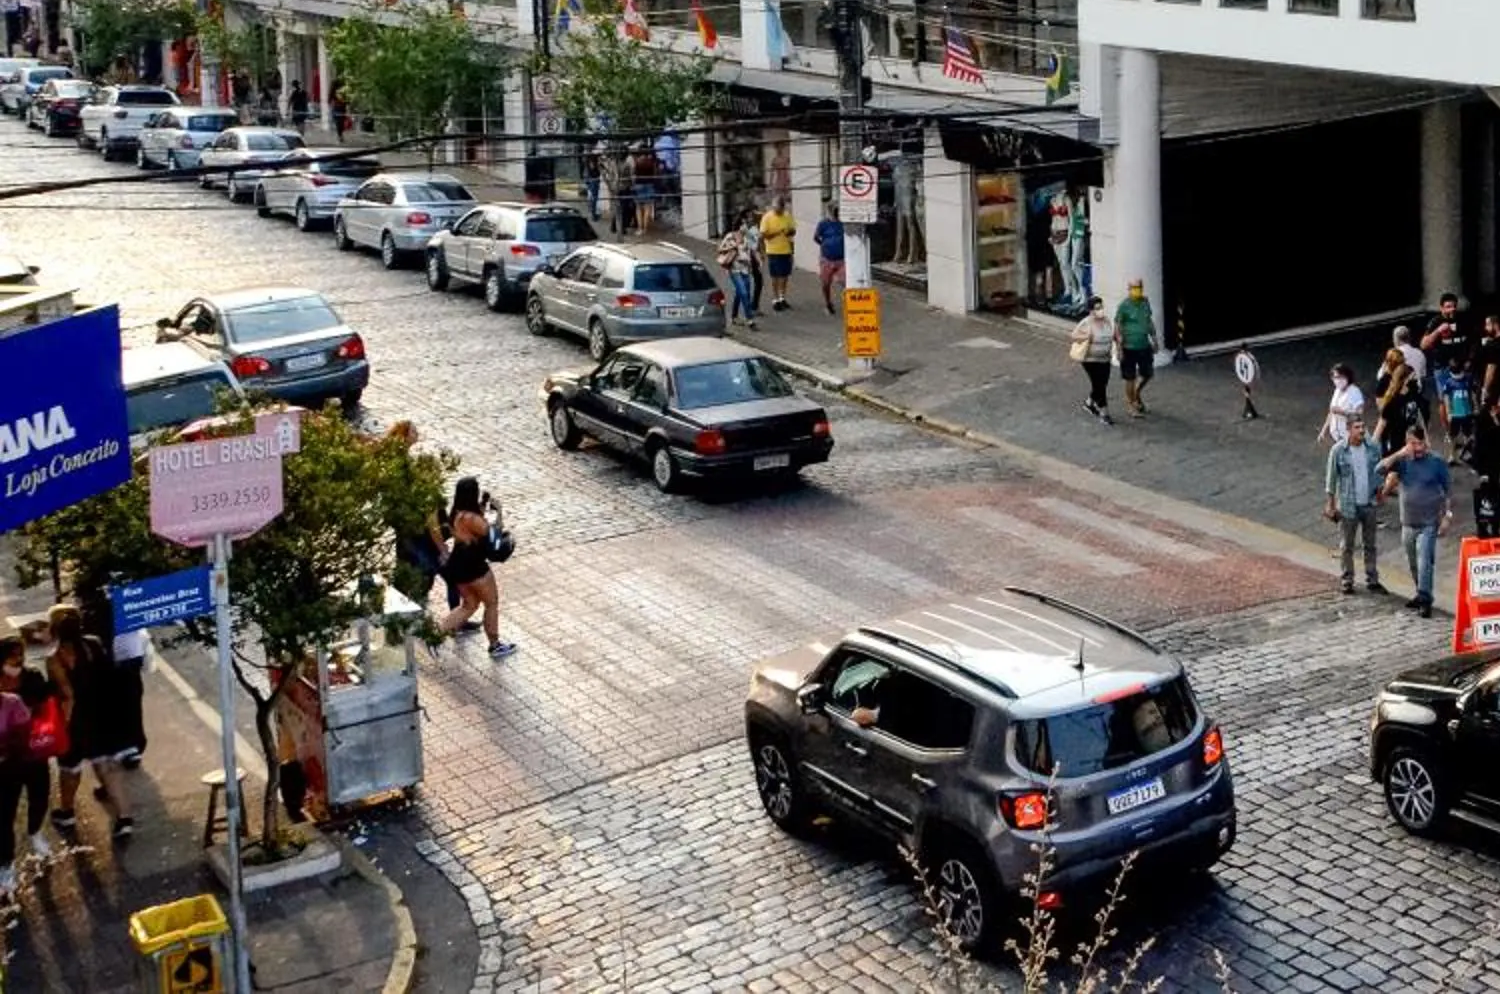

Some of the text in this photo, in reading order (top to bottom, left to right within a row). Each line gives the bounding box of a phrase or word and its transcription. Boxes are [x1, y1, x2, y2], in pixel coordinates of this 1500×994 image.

[5, 438, 119, 497] Loja Conceito
[155, 436, 278, 473] HOTEL BRASIL
